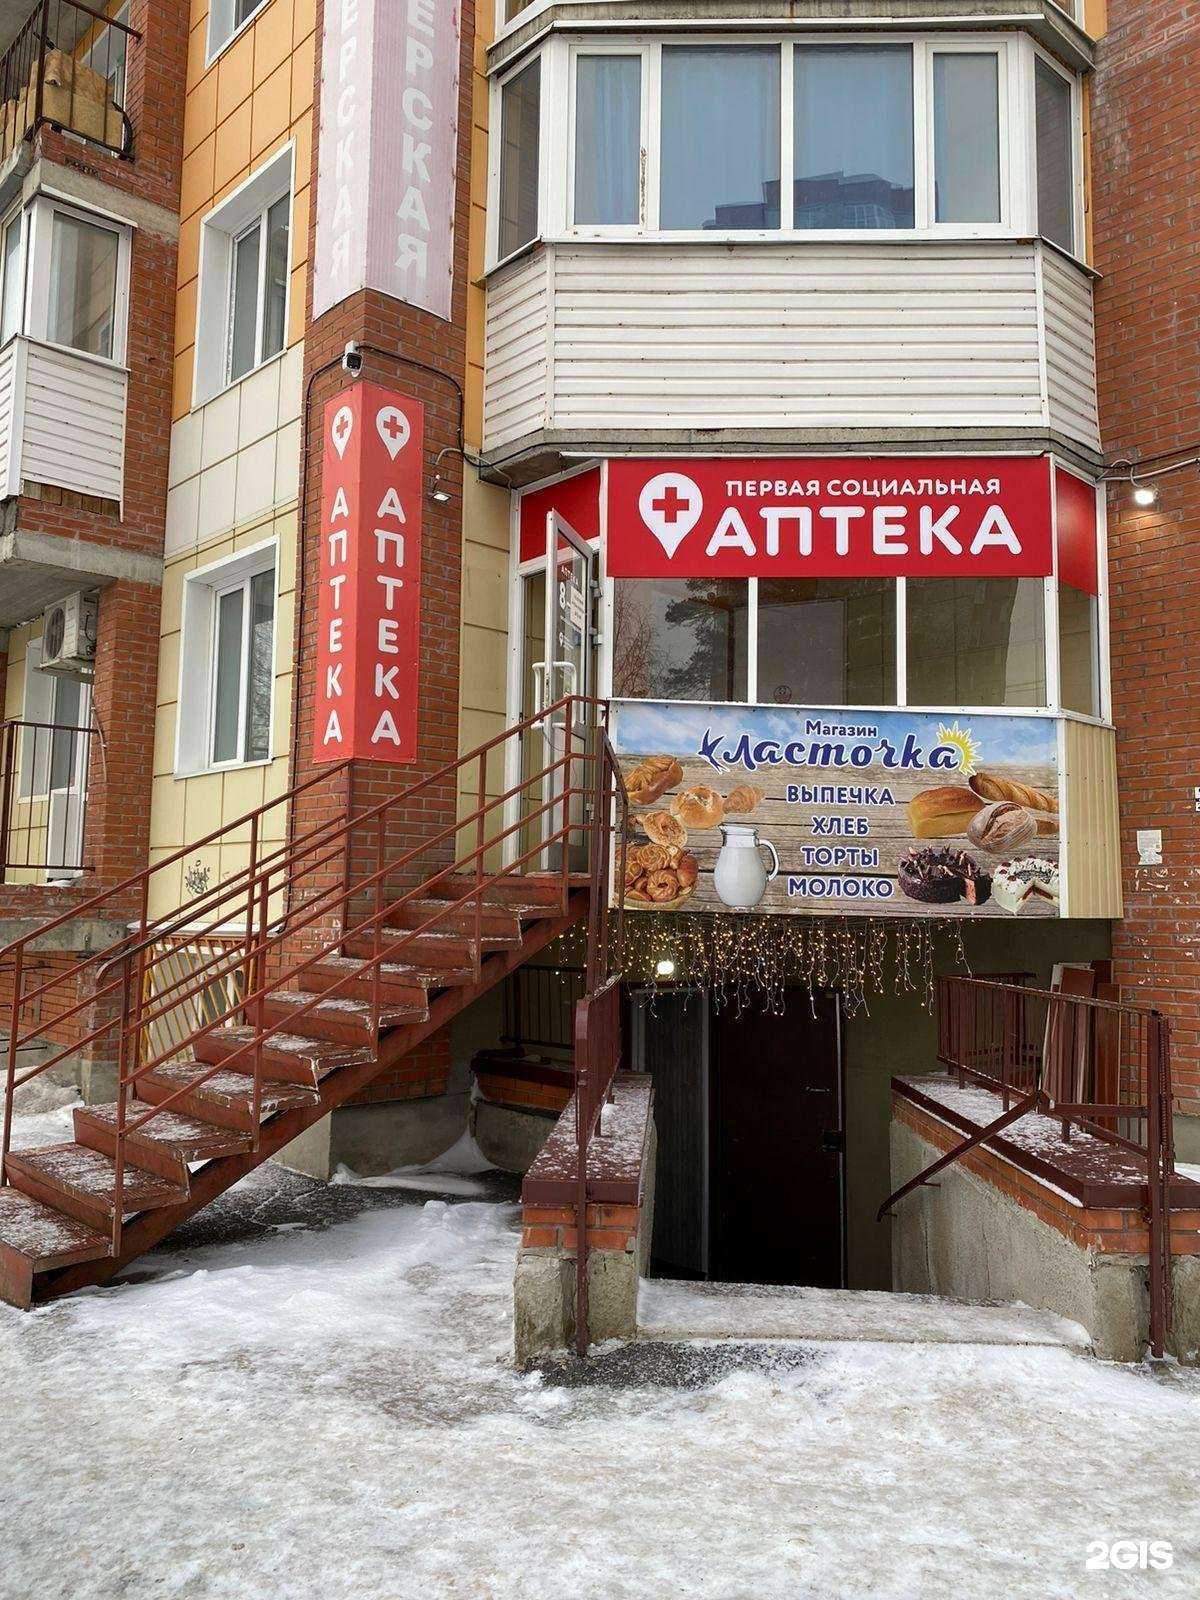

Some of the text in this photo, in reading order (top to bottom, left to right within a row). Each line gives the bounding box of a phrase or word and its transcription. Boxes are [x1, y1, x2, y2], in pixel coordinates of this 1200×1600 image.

[725, 478, 1001, 499] ПЕРВАЯ СОЦИАЛЬНАЯ
[705, 505, 1024, 557] АПТЕКА
[323, 486, 350, 746] АПТЕКА
[371, 487, 406, 745] АПТЕКА
[805, 719, 878, 738] Магазин
[721, 734, 960, 771] Ласточка
[786, 785, 895, 806] ВЫПЕЧКА
[811, 816, 869, 836] ХЛЕБ
[802, 847, 878, 867] ТОРТЫ
[788, 878, 894, 899] МОЛОКО
